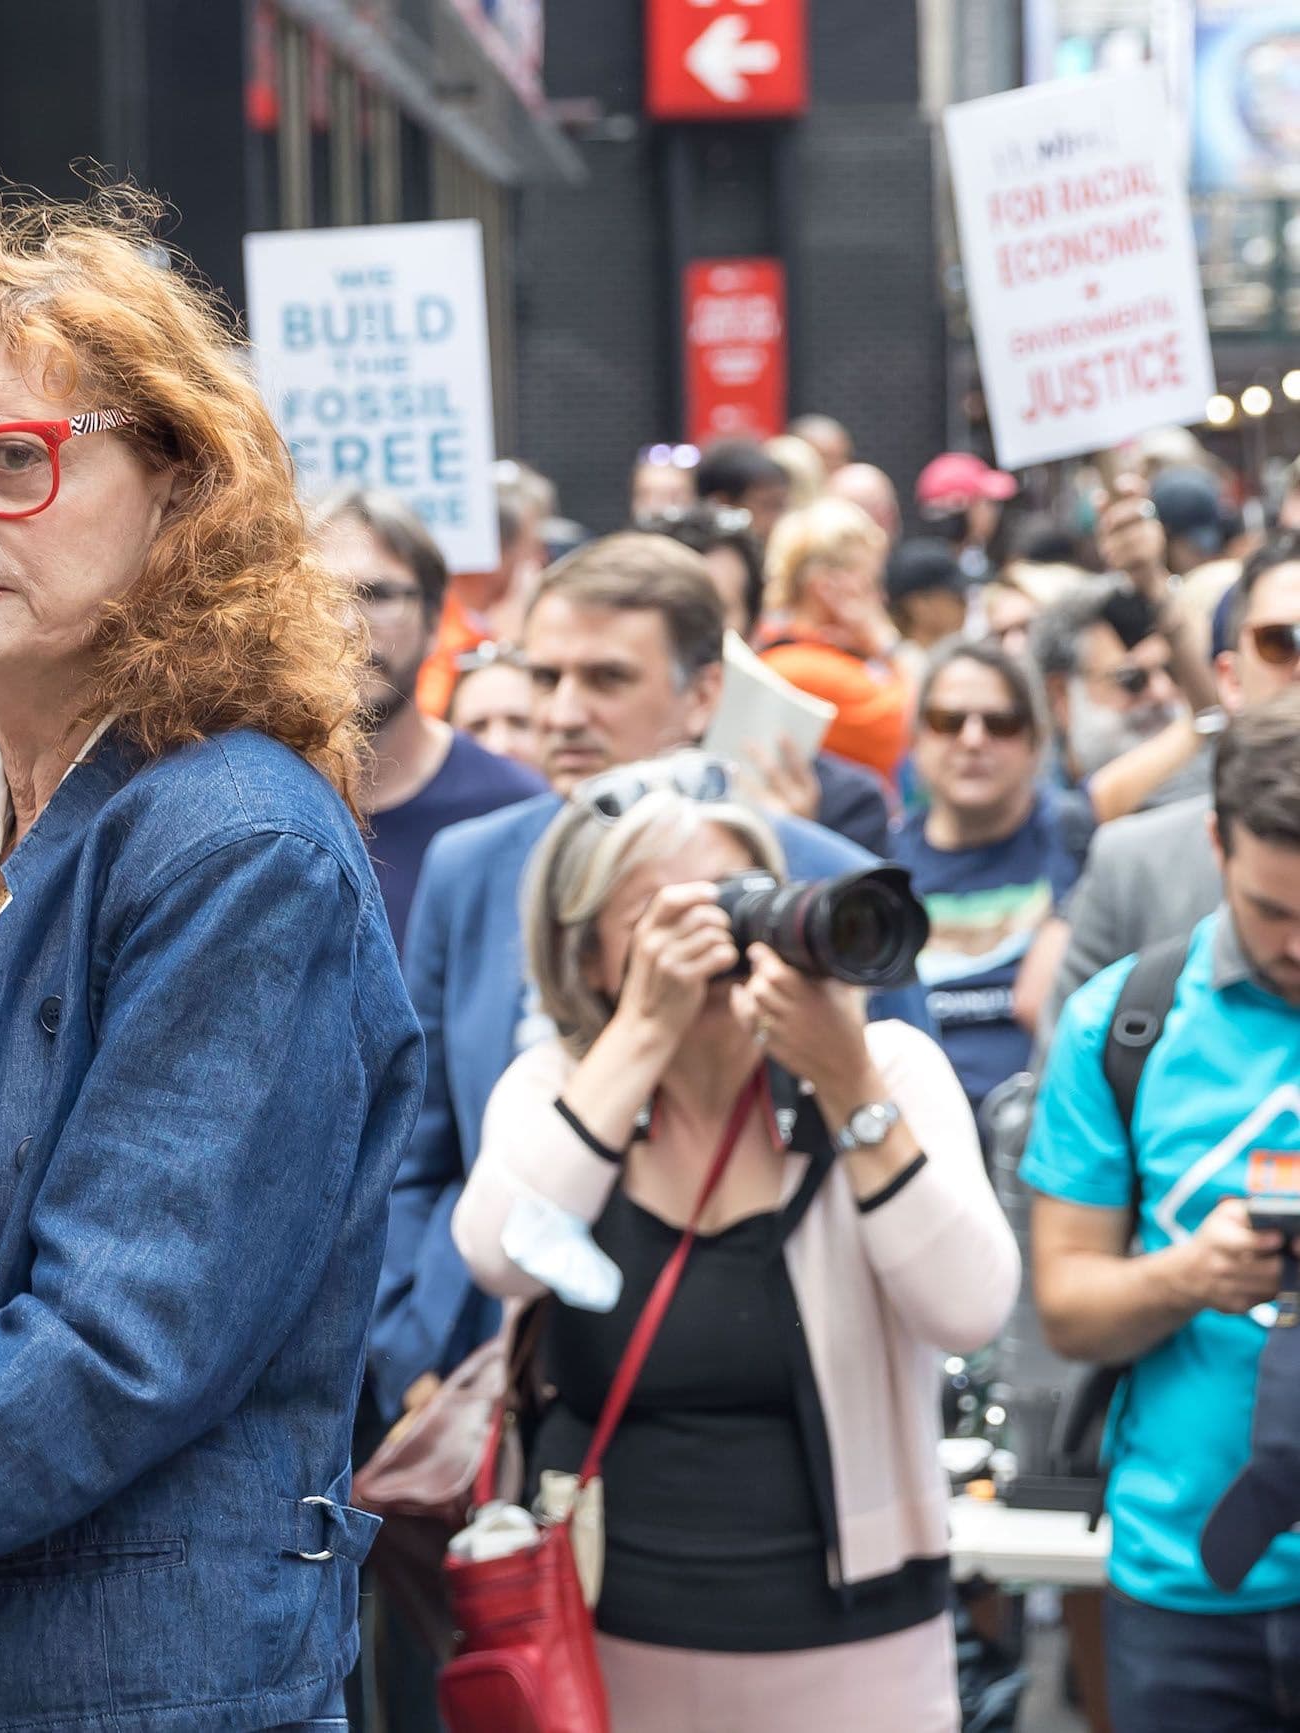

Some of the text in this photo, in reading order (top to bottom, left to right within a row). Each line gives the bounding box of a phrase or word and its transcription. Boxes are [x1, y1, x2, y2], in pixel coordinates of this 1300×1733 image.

[996, 208, 1169, 288] ECONOMIC
[278, 294, 455, 350] BUILD
[281, 382, 457, 426] FOSSIL
[1022, 332, 1187, 424] JUSTICE
[288, 428, 463, 486] FREE
